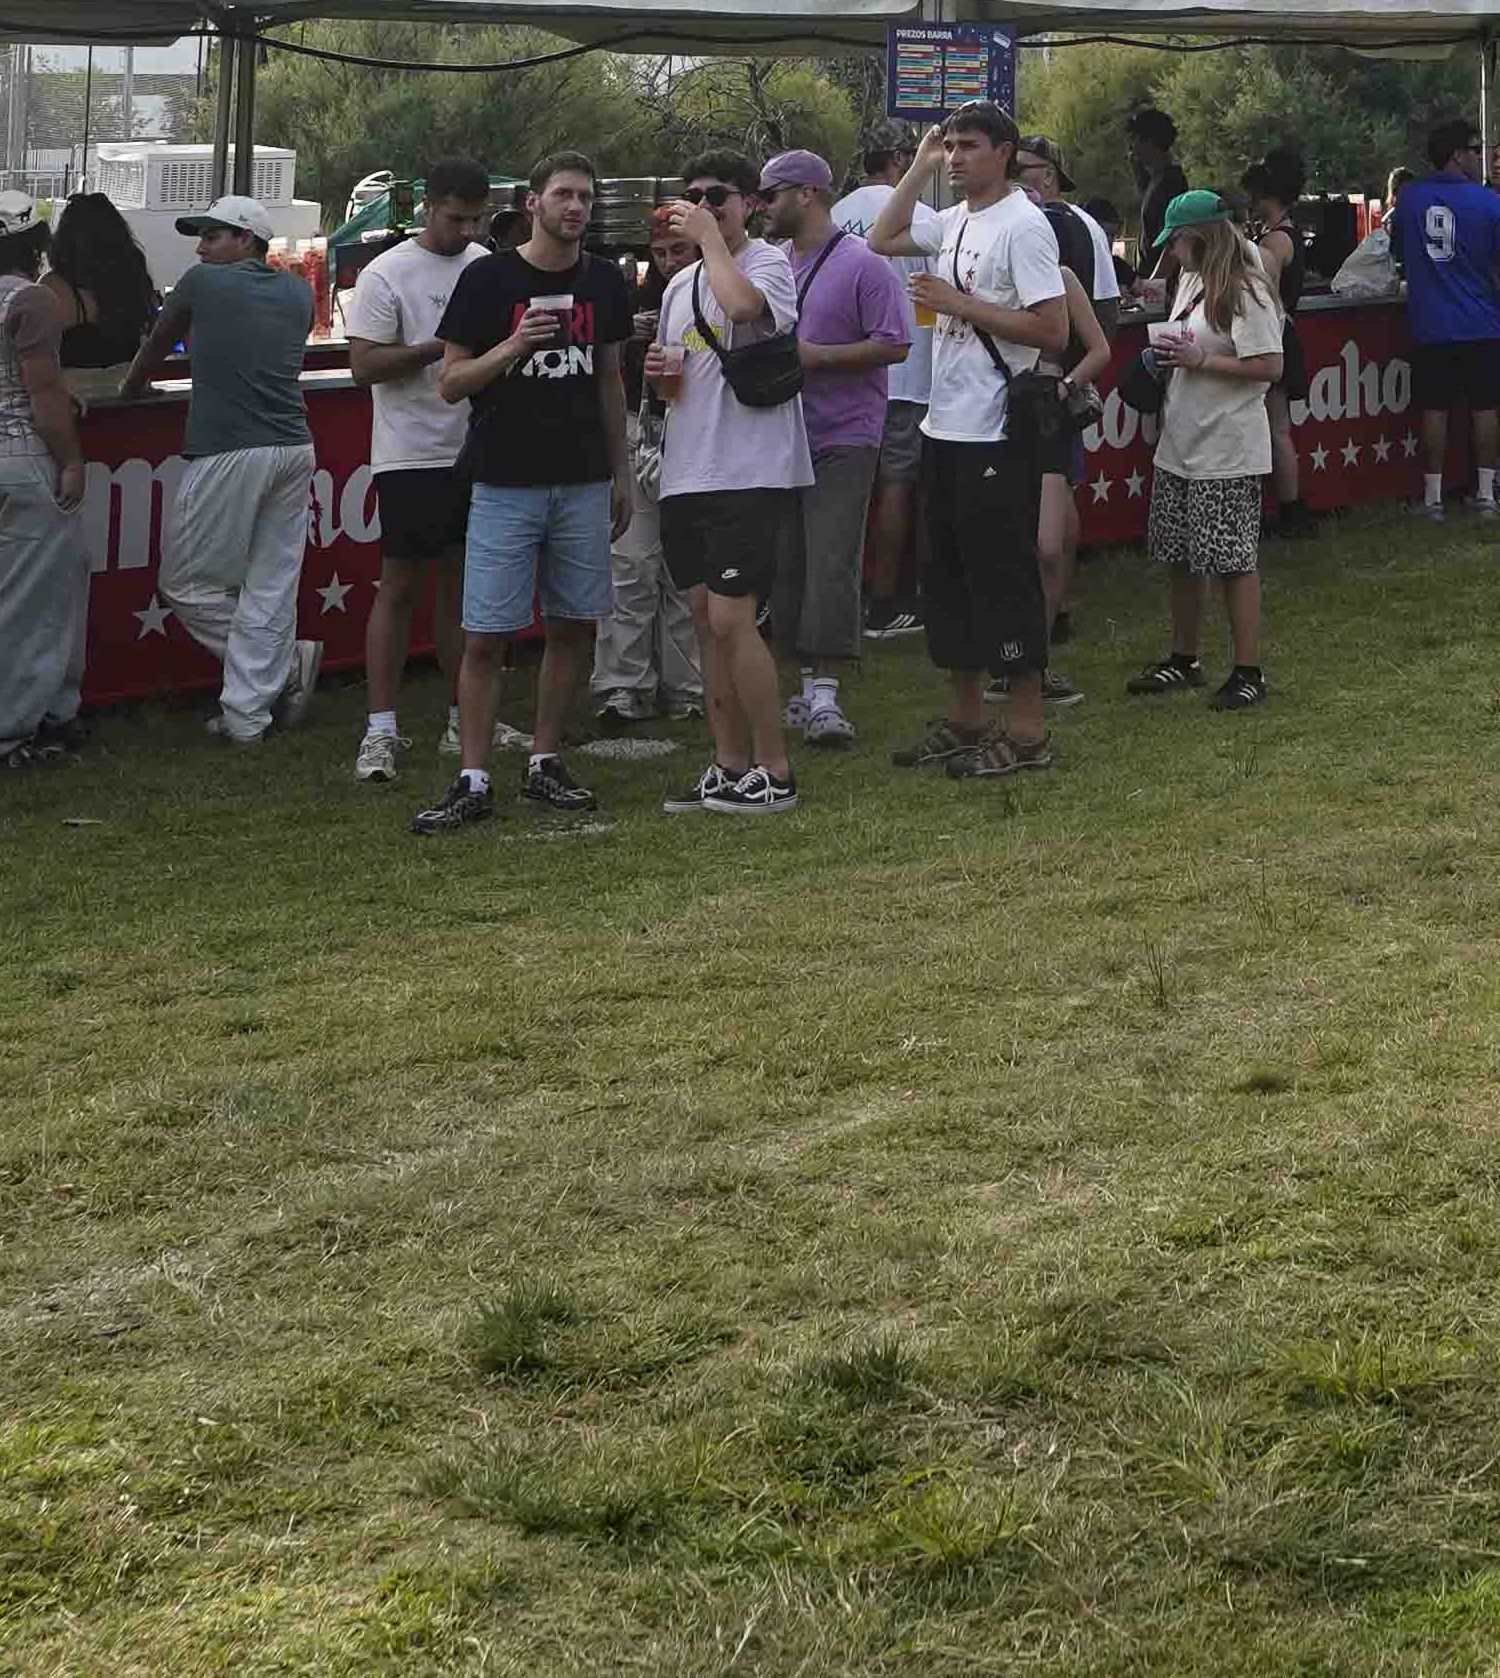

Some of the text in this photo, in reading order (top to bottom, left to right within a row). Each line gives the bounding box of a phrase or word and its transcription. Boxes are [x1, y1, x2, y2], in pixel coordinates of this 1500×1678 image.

[896, 29, 953, 41] PREZOS BARRA
[1426, 205, 1455, 261] 9
